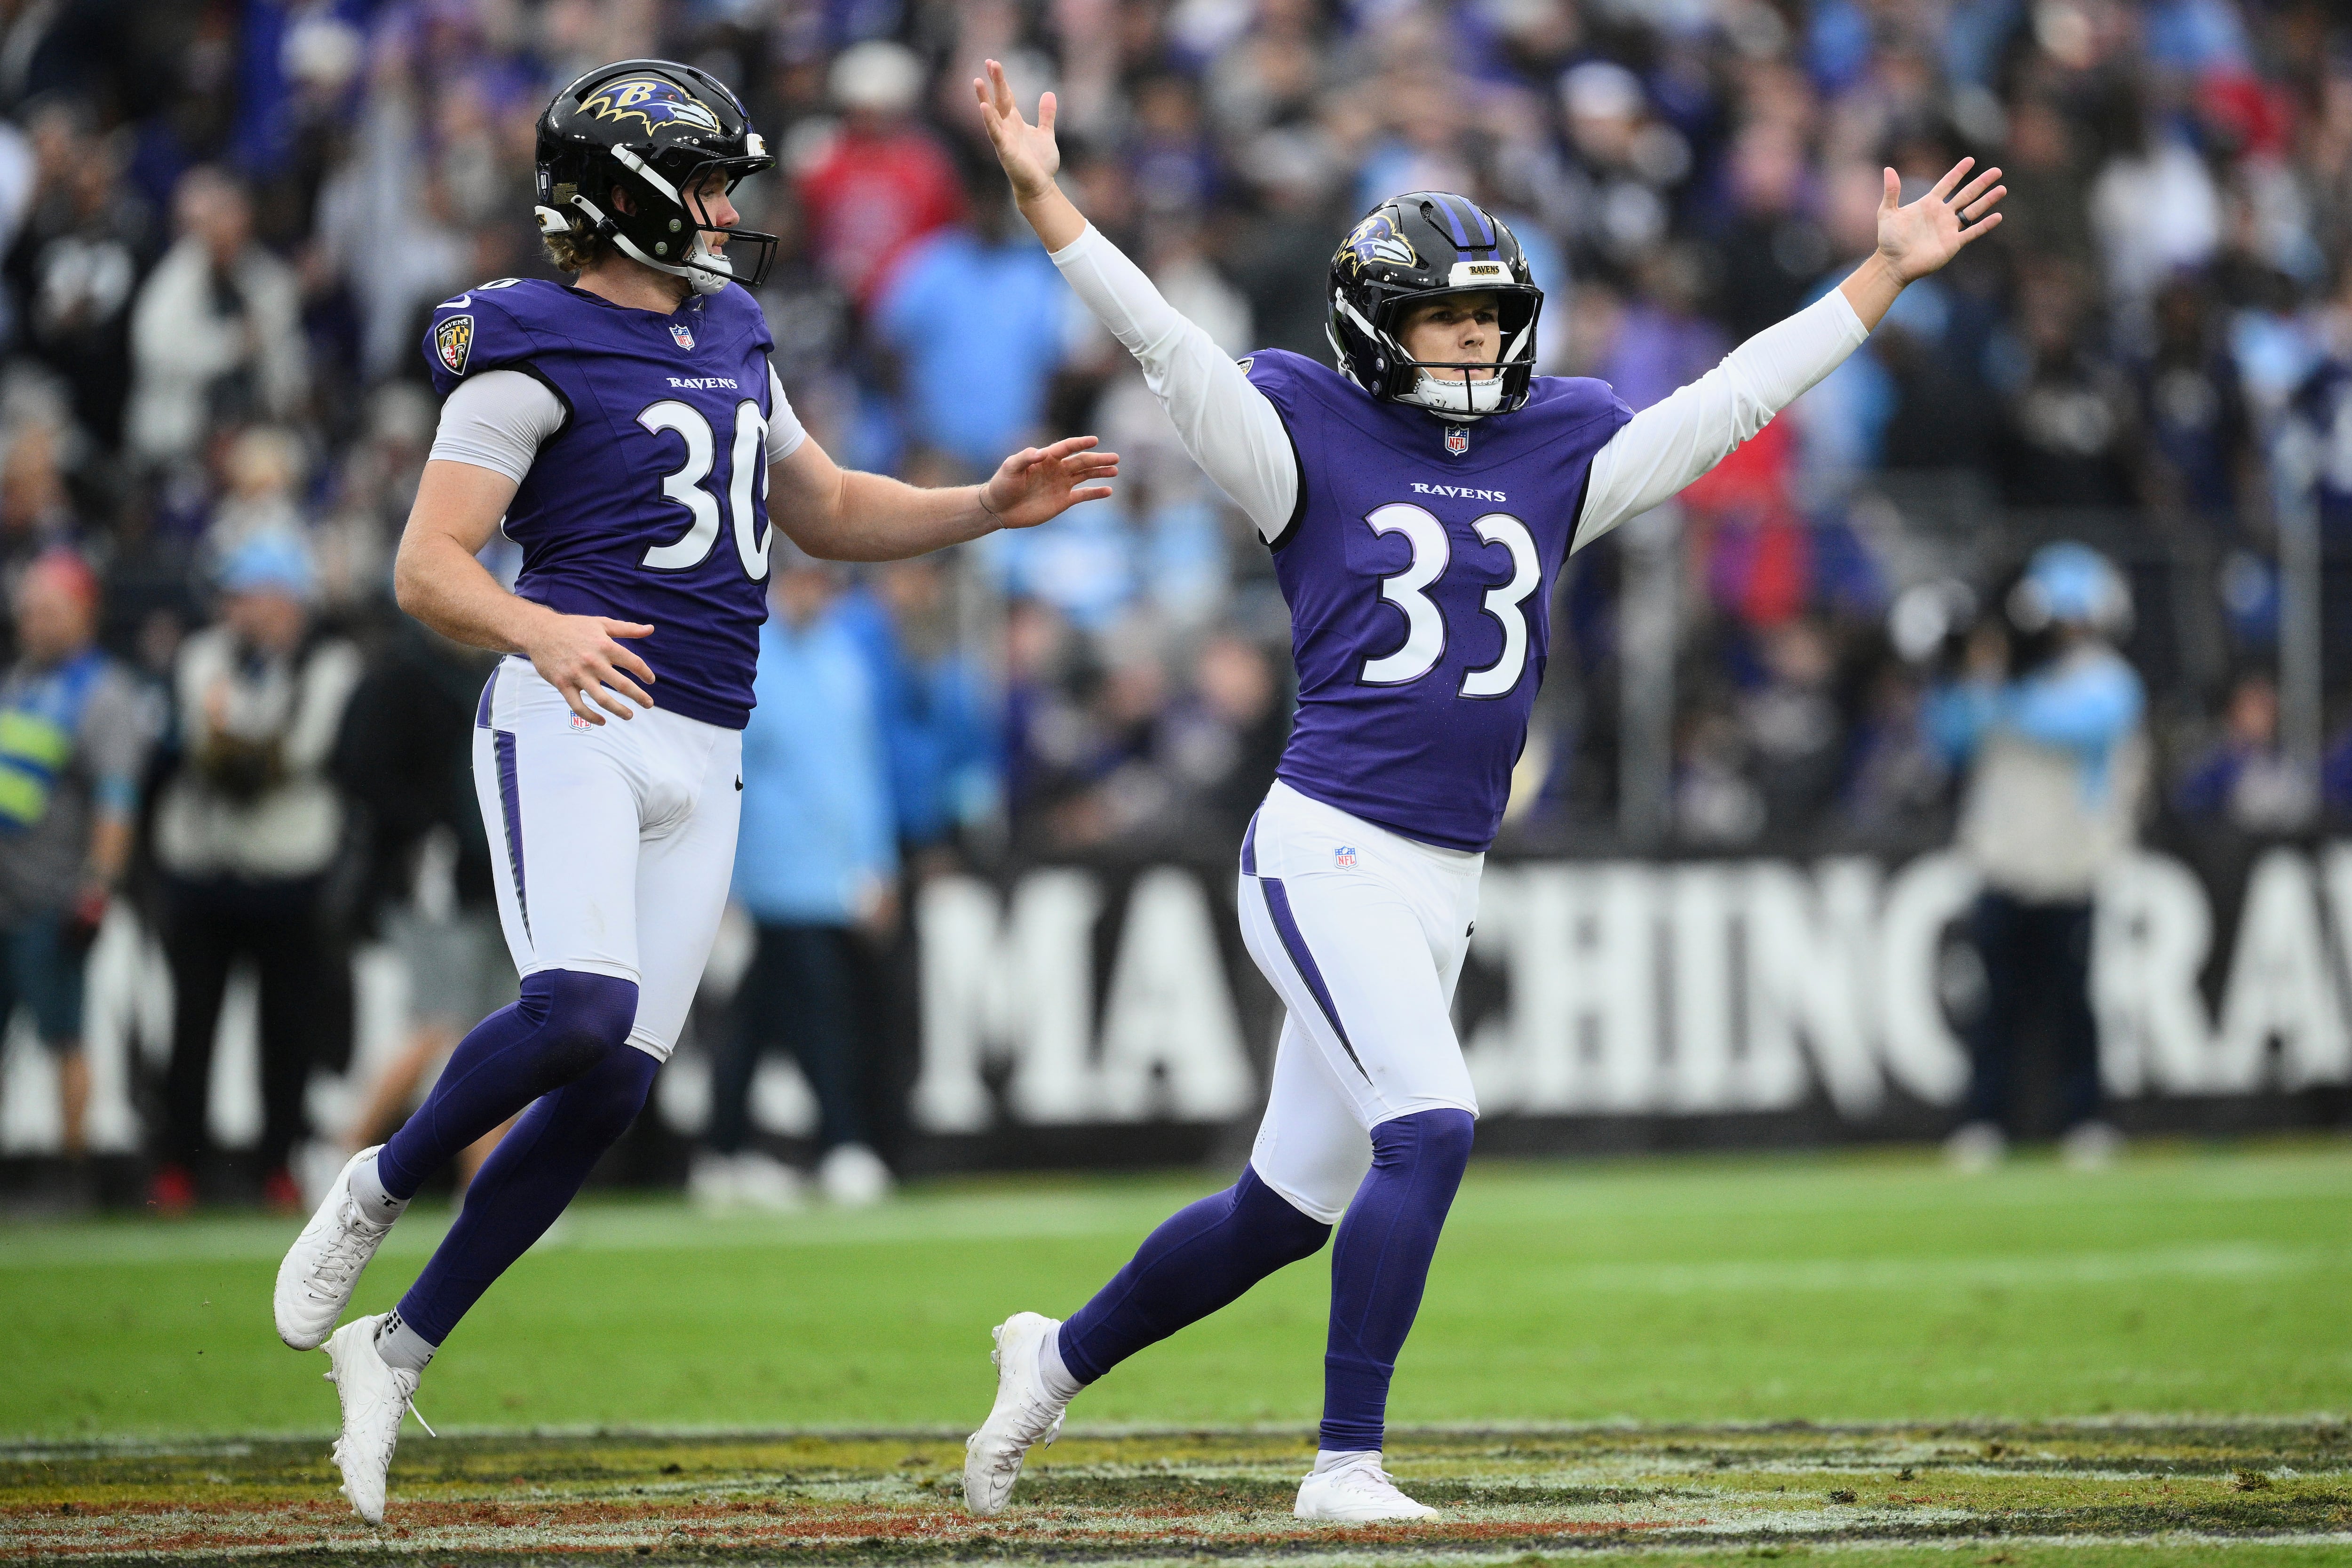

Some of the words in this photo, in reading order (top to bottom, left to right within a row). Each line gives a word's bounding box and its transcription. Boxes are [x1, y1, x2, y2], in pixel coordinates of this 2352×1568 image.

[1469, 265, 1500, 275] RAVENS
[438, 318, 469, 334] RAVENS
[677, 335, 691, 346] NFL
[666, 377, 738, 390] RAVENS
[1448, 437, 1465, 450] NFL
[636, 398, 773, 586] 30
[1410, 483, 1507, 502] RAVENS
[1355, 501, 1542, 701] 33
[573, 717, 590, 727] NFL
[1337, 855, 1355, 866] NFL
